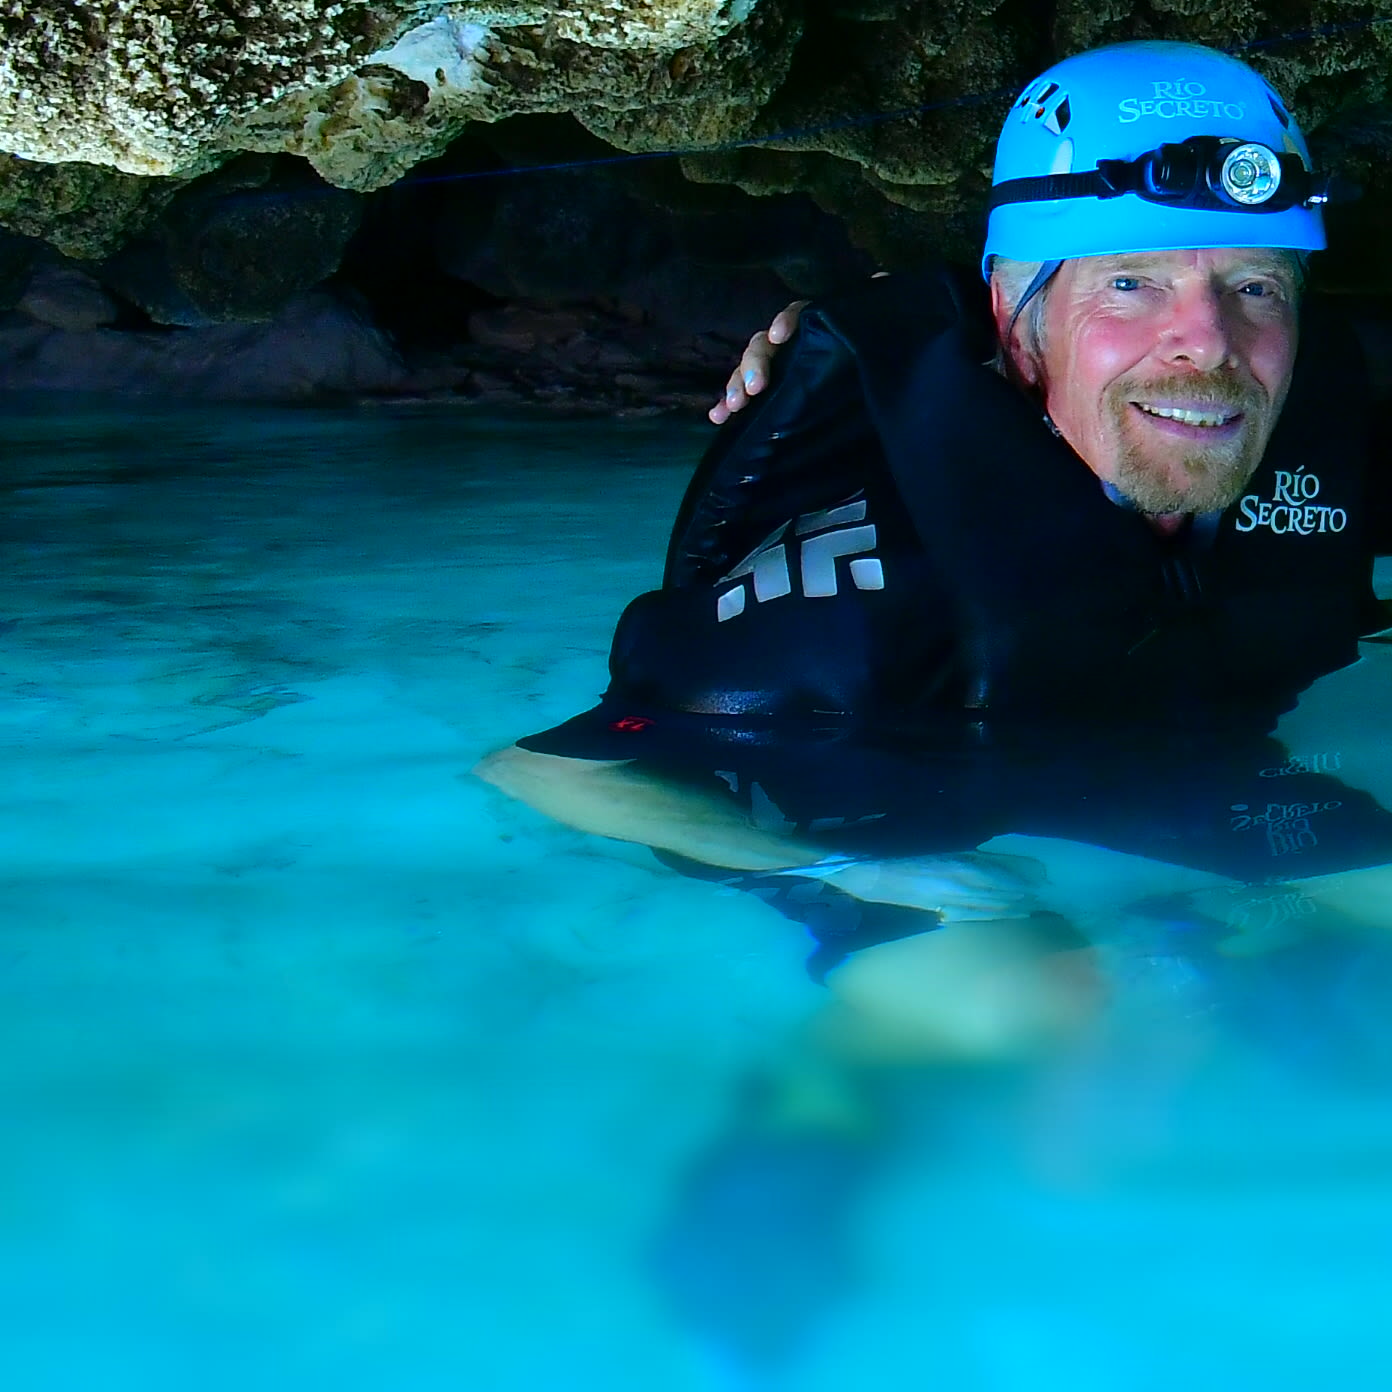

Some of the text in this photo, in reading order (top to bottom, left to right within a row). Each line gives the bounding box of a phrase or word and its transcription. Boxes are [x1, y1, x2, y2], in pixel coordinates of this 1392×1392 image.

[1150, 77, 1207, 100] RÍO
[1118, 97, 1244, 123] SECRETO
[1272, 464, 1320, 506] RÍO
[1235, 494, 1347, 535] SECRETO
